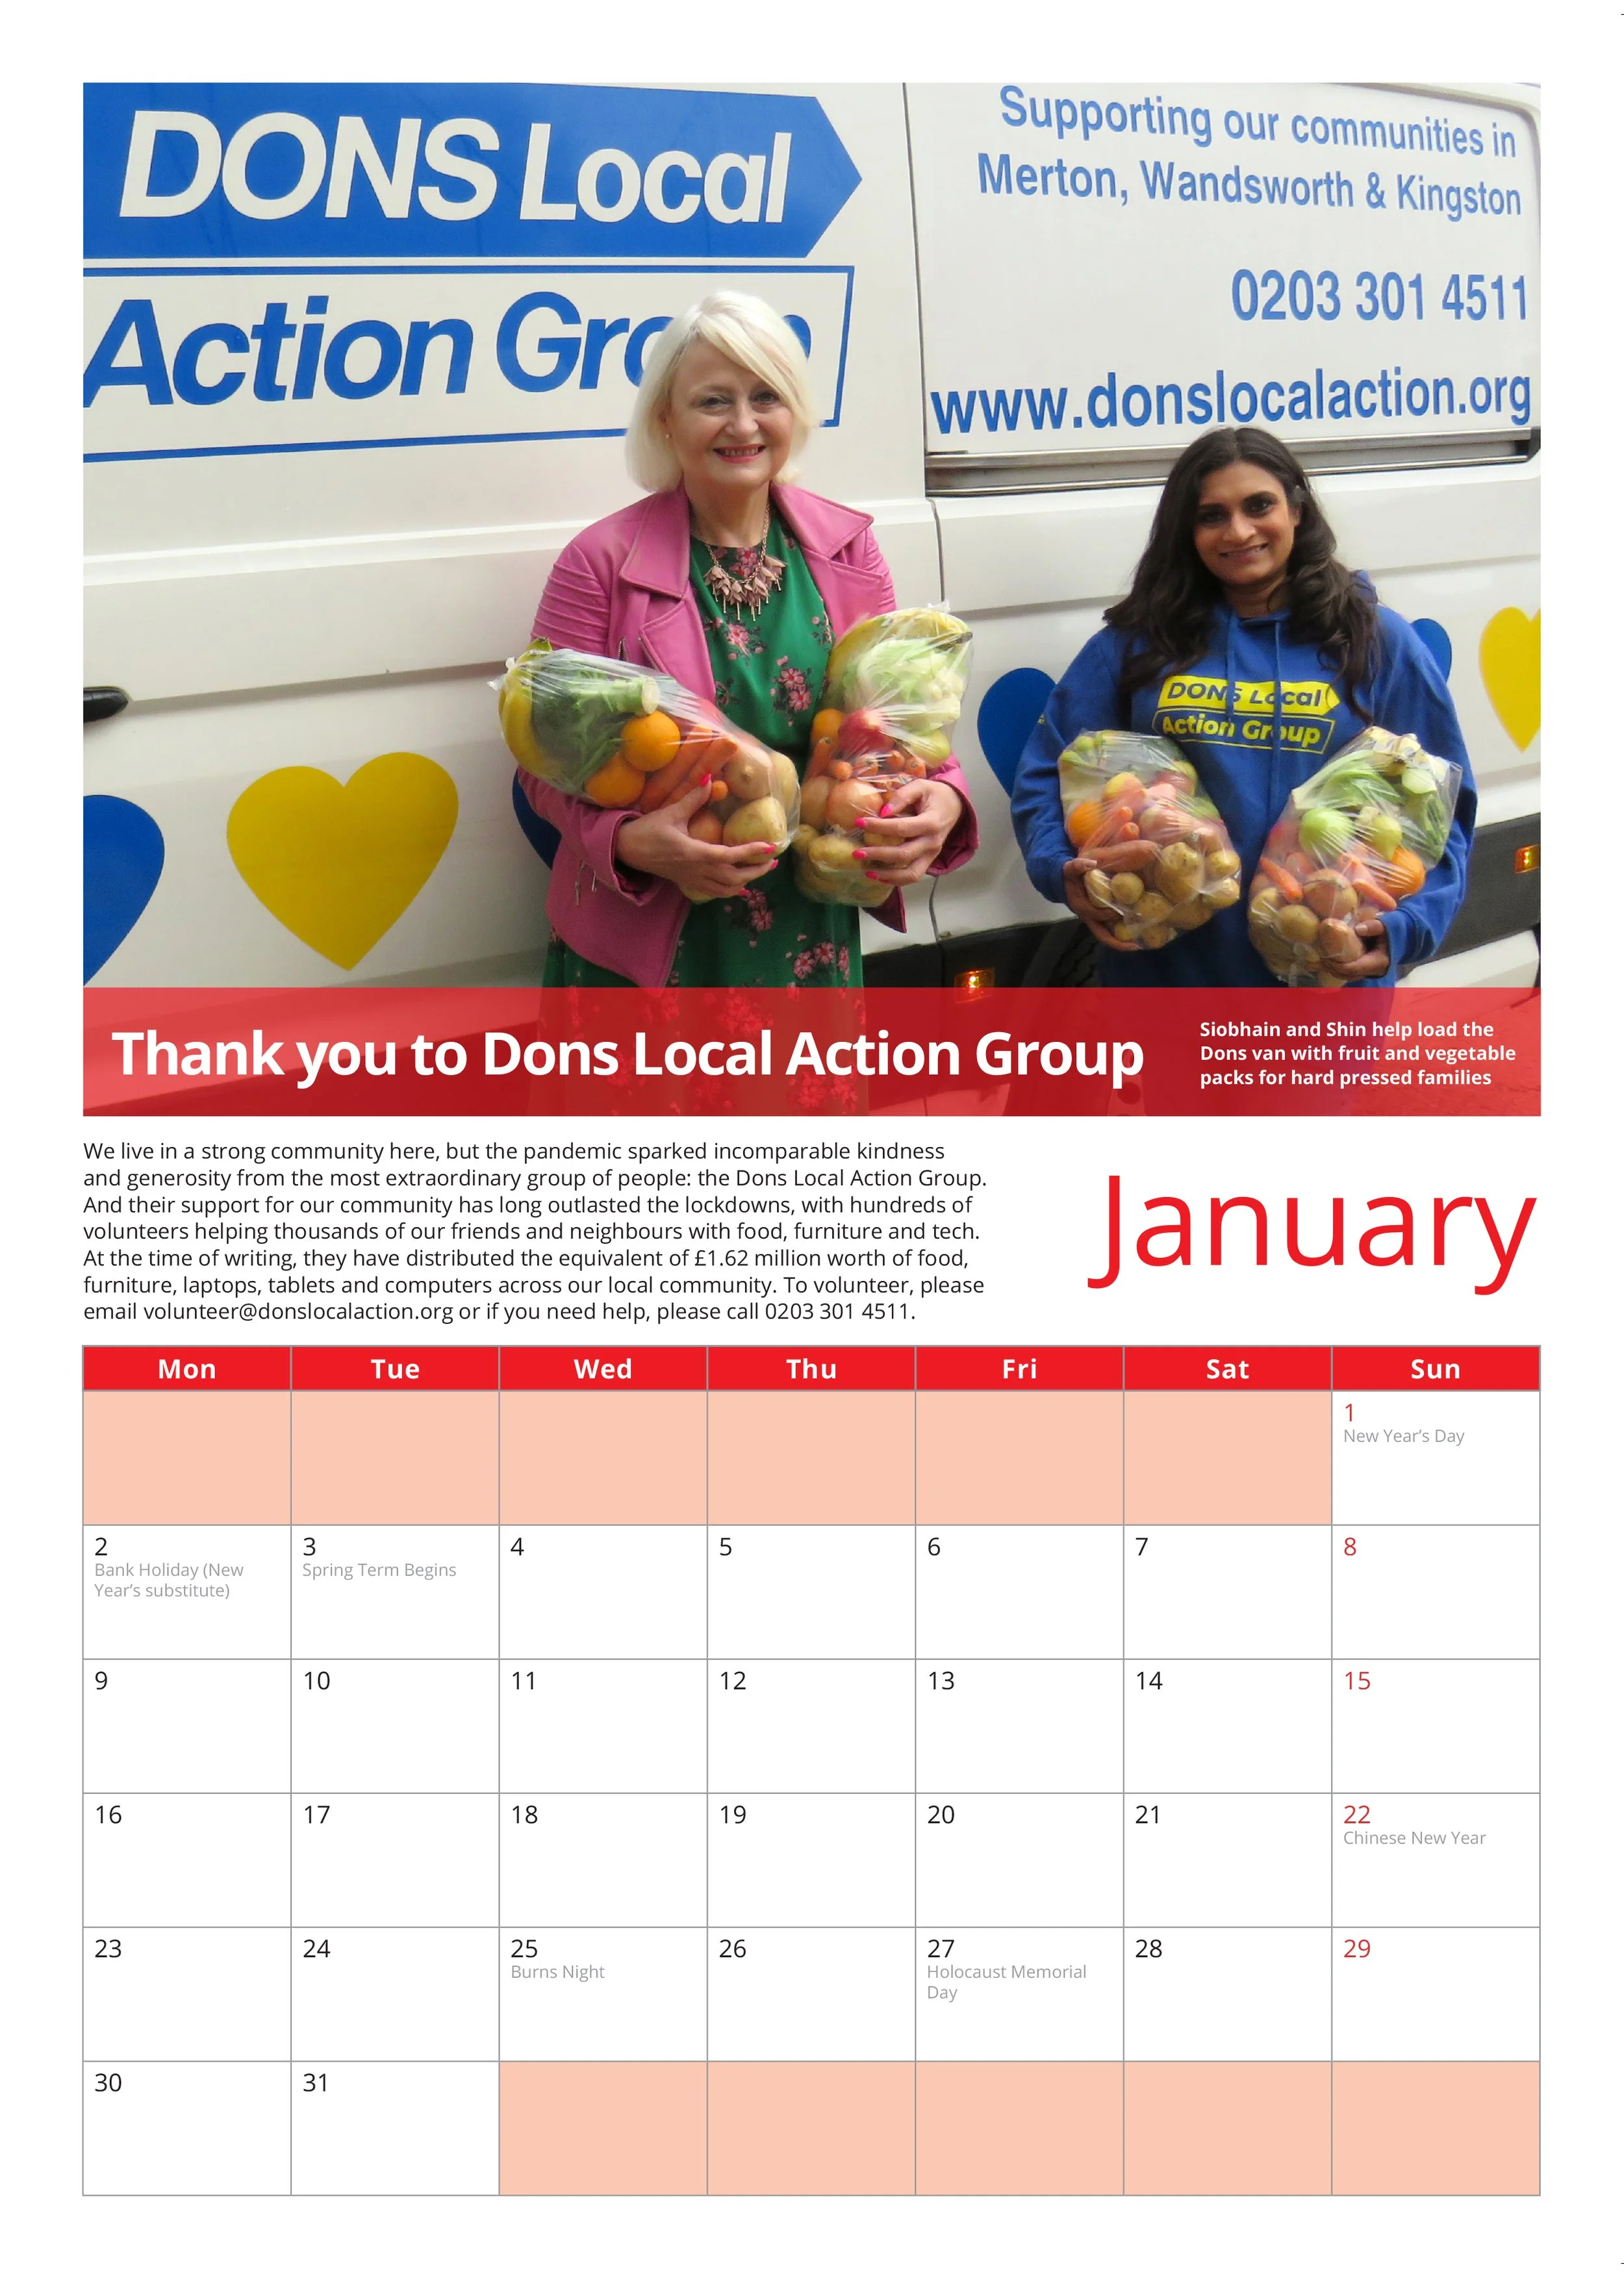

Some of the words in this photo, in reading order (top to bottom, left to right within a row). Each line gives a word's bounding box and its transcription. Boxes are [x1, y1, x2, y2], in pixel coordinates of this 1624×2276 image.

[1000, 85, 1212, 147] Supporting
[1224, 106, 1278, 140] our
[1290, 114, 1484, 155] communities
[1491, 121, 1516, 157] in
[120, 110, 499, 221] DONS
[519, 122, 793, 224] Local
[978, 153, 1129, 206] Merton,
[1139, 160, 1354, 208] Wandsworth
[1365, 175, 1386, 209] &
[1397, 175, 1522, 222] Kingston
[1233, 270, 1340, 321] 0203
[1356, 272, 1423, 320] 301
[1443, 275, 1526, 320] 4511
[83, 296, 474, 408] Action
[931, 366, 1532, 434] www.donslocalaction.org
[1162, 713, 1236, 738] Action
[83, 1143, 115, 1159] We
[121, 1141, 154, 1159] live
[160, 1142, 177, 1159] in
[183, 1146, 194, 1159] a
[201, 1144, 266, 1165] strong
[271, 1142, 385, 1165] community
[390, 1141, 440, 1162] here,
[446, 1141, 479, 1159] but
[485, 1141, 518, 1159] the
[524, 1141, 622, 1165] pandemic
[628, 1141, 707, 1165] sparked
[715, 1141, 850, 1165] incomparable
[857, 1141, 945, 1159] kindness
[83, 1169, 120, 1187] and
[127, 1169, 232, 1191] generosity
[236, 1169, 285, 1187] from
[290, 1169, 324, 1187] the
[331, 1170, 380, 1187] most
[386, 1169, 522, 1191] extraordinary
[527, 1173, 586, 1191] group
[592, 1169, 613, 1187] of
[618, 1169, 691, 1191] people:
[697, 1169, 730, 1187] the
[737, 1169, 787, 1187] Dons
[794, 1169, 844, 1187] Local
[850, 1169, 912, 1187] Action
[919, 1169, 987, 1191] Group.
[1087, 1175, 1538, 1296] January
[82, 1250, 105, 1267] At
[109, 1248, 142, 1267] the
[147, 1249, 192, 1267] time
[199, 1248, 220, 1267] of
[224, 1249, 297, 1271] writing,
[303, 1248, 348, 1271] they
[353, 1248, 400, 1267] have
[406, 1248, 514, 1267] distributed
[520, 1248, 553, 1267] the
[559, 1248, 663, 1272] equivalent
[669, 1248, 691, 1267] of
[694, 1250, 748, 1267] £1.62
[755, 1248, 820, 1267] million
[827, 1248, 885, 1267] worth
[893, 1248, 913, 1267] of
[917, 1248, 968, 1269] food,
[84, 1302, 136, 1320] email
[143, 1302, 453, 1324] volunteer@donslocalaction.org
[458, 1306, 481, 1320] or
[487, 1302, 500, 1320] if
[503, 1306, 540, 1324] you
[547, 1306, 596, 1320] need
[603, 1302, 650, 1324] help,
[657, 1302, 721, 1324] please
[727, 1302, 758, 1320] call
[765, 1302, 814, 1320] 0203
[819, 1302, 852, 1320] 301
[861, 1302, 915, 1320] 4511.
[159, 1359, 215, 1379] Mon
[370, 1359, 420, 1379] Tue
[574, 1358, 631, 1379] Wed
[786, 1358, 836, 1379] Thu
[1004, 1358, 1036, 1379] Fri
[1207, 1359, 1249, 1379] Sat
[1411, 1359, 1460, 1379] Sun
[1345, 1403, 1352, 1422] 1
[1344, 1429, 1379, 1443] New
[1435, 1429, 1465, 1447] Day
[95, 1537, 108, 1556] 2
[303, 1537, 316, 1556] 3
[510, 1537, 525, 1556] 4
[719, 1537, 732, 1556] 5
[928, 1537, 941, 1556] 6
[1135, 1537, 1148, 1556] 7
[1344, 1537, 1357, 1556] 8
[95, 1562, 134, 1577] Bank
[140, 1562, 199, 1580] Holiday
[203, 1563, 244, 1579] (New
[303, 1563, 353, 1580] Spring
[357, 1563, 399, 1576] Term
[405, 1563, 457, 1580] Begins
[146, 1583, 230, 1600] substitute)
[96, 1804, 122, 1825] 16
[304, 1805, 331, 1824] 17
[512, 1804, 538, 1825] 18
[720, 1804, 746, 1825] 19
[928, 1804, 955, 1825] 20
[1135, 1804, 1158, 1824] 21
[1343, 1804, 1371, 1824] 22
[1343, 1830, 1406, 1845] Chinese
[1412, 1831, 1447, 1845] New
[1451, 1831, 1487, 1845] Year
[95, 1939, 121, 1958] 23
[303, 1939, 331, 1958] 24
[511, 1939, 538, 1958] 25
[719, 1939, 746, 1958] 26
[928, 1939, 955, 1958] 27
[1135, 1939, 1163, 1958] 28
[1343, 1939, 1371, 1958] 29
[511, 1965, 557, 1979] Burns
[563, 1964, 605, 1982] Night
[928, 1964, 1007, 1979] Holocaust
[1011, 1964, 1086, 1979] Memorial
[928, 1986, 958, 2003] Day
[95, 2073, 122, 2092] 30
[303, 2073, 326, 2092] 31
